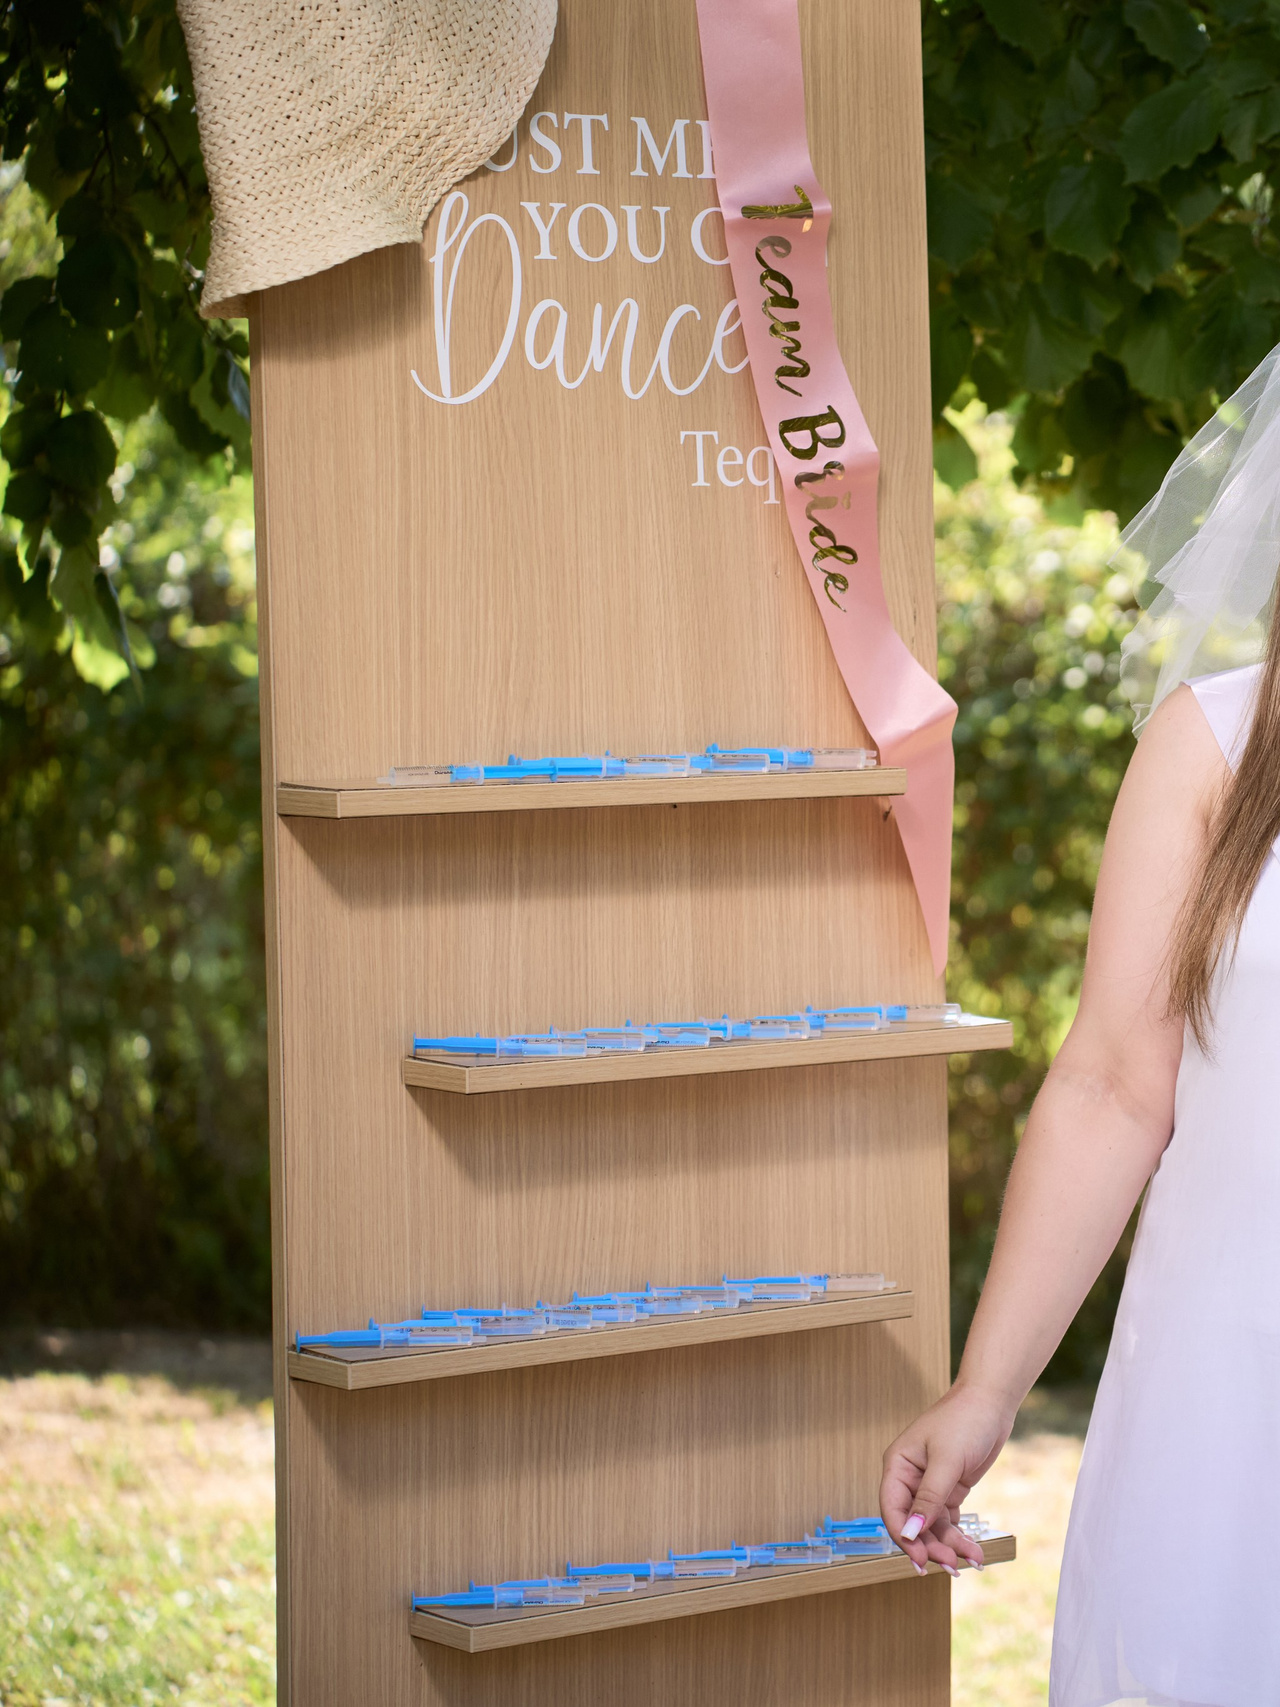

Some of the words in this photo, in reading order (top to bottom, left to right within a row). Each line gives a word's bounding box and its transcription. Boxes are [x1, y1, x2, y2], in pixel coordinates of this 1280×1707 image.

[411, 191, 751, 404] Dance
[520, 202, 671, 263] YOU
[741, 184, 814, 397] Team
[779, 405, 859, 612] Bride
